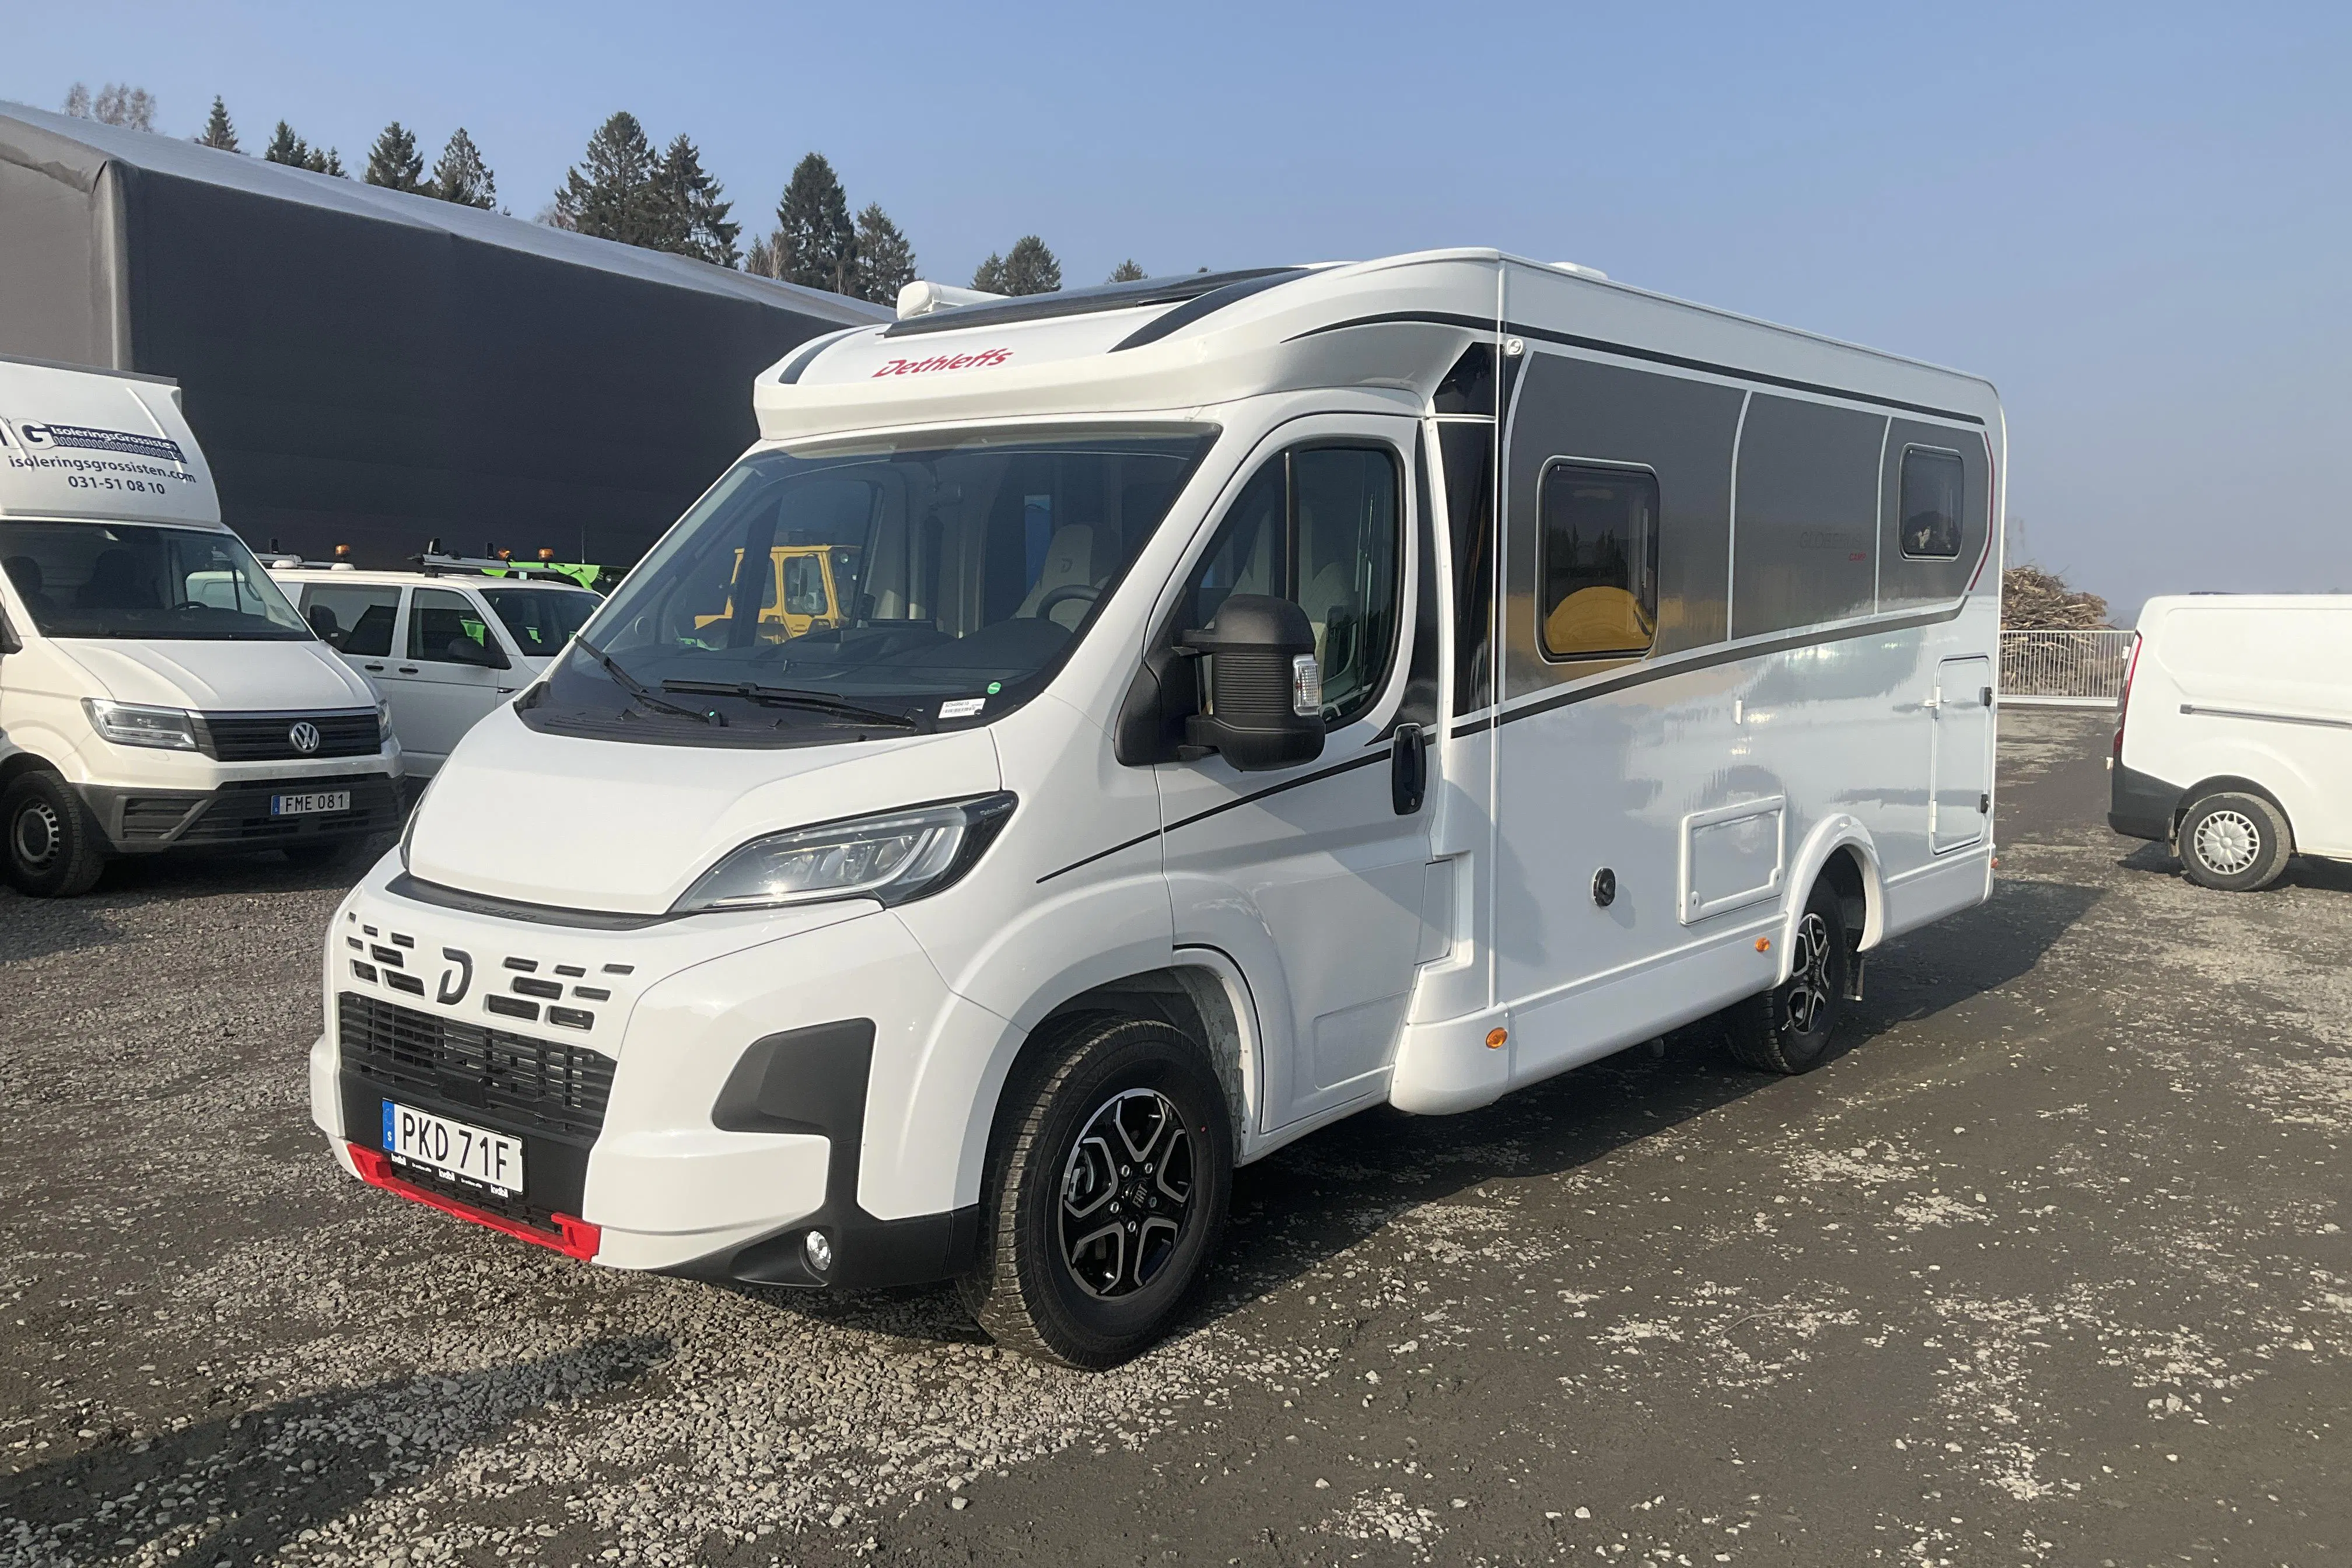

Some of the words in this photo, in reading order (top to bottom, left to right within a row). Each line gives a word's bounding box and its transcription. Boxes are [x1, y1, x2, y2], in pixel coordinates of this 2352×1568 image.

[871, 348, 1014, 378] Dethleffs
[8, 455, 197, 483] isoleringsgrossisten.com
[68, 476, 121, 490] 031-51
[127, 480, 145, 492] 08
[148, 482, 165, 494] 10
[289, 722, 320, 753] VW
[286, 796, 312, 812] FME
[318, 794, 343, 808] 081
[387, 1131, 392, 1142] S
[402, 1112, 448, 1161] PKD
[459, 1129, 509, 1180] 71F
[1132, 1184, 1147, 1208] FIAT
